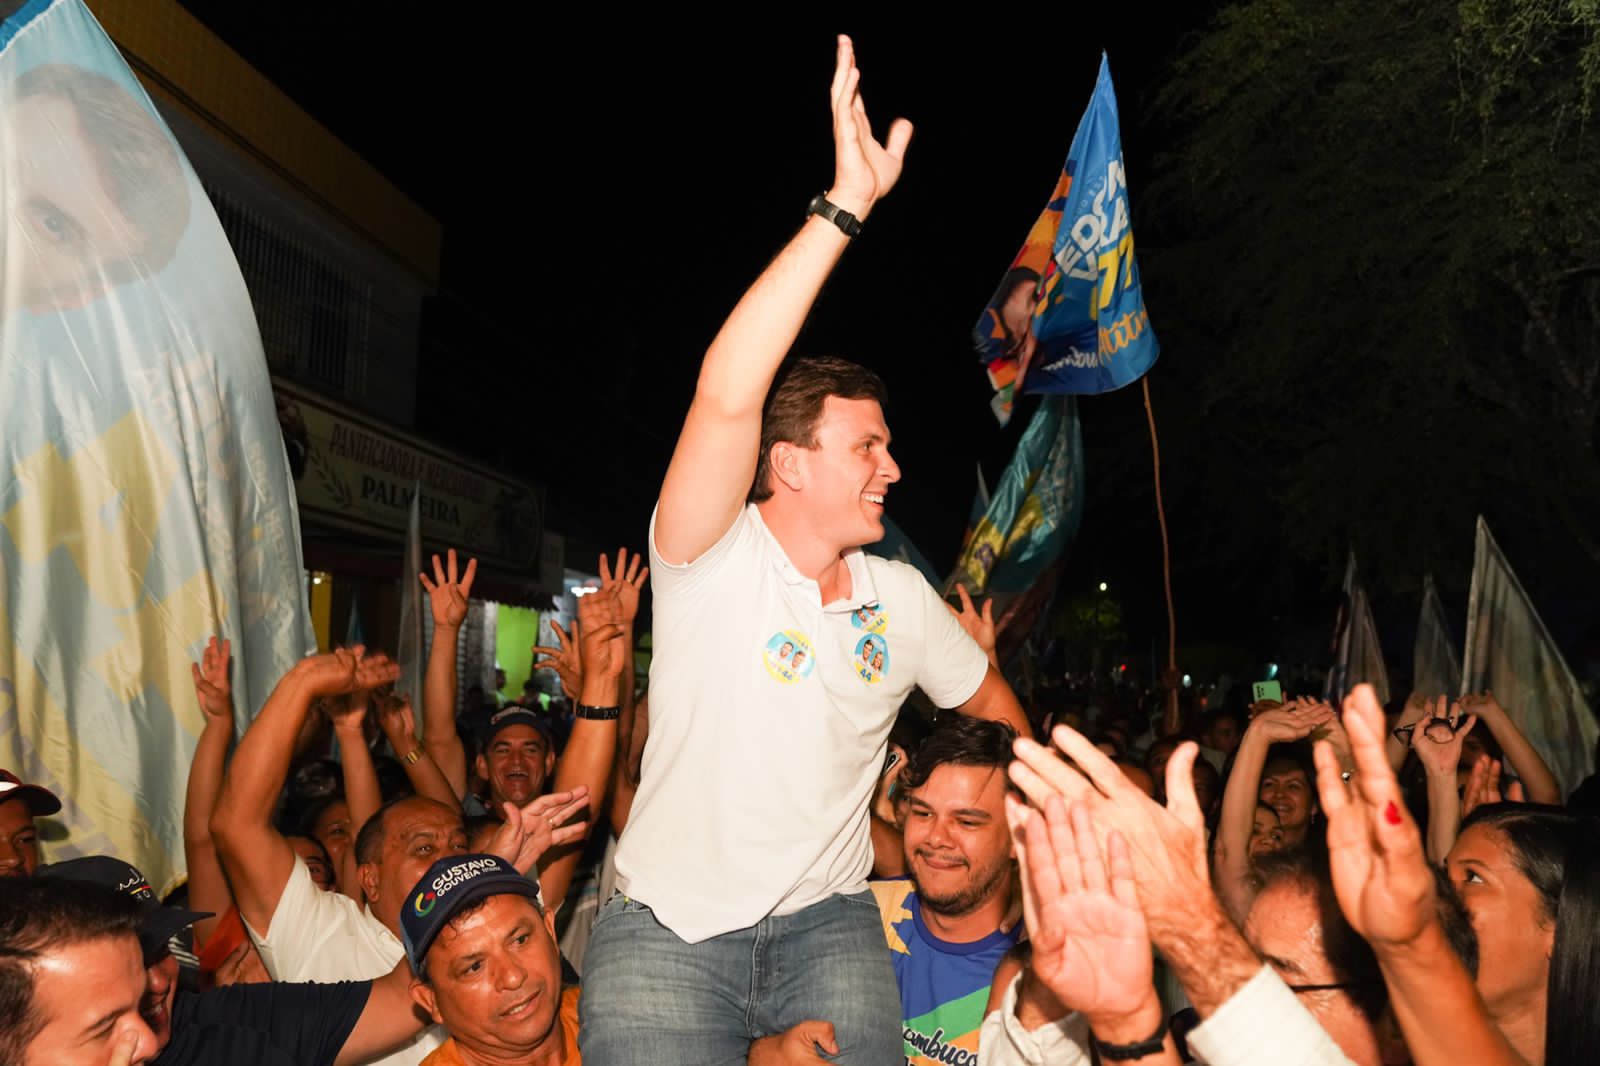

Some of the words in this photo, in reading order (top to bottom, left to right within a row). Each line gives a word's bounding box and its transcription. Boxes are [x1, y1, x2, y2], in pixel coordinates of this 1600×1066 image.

[1055, 155, 1126, 275] EDSN
[329, 423, 417, 480] PANIFICADORA
[361, 474, 461, 526] PALMEIRA
[860, 668, 872, 682] 44
[431, 858, 497, 891] GUSTAVO
[437, 869, 481, 897] GOUVEIA
